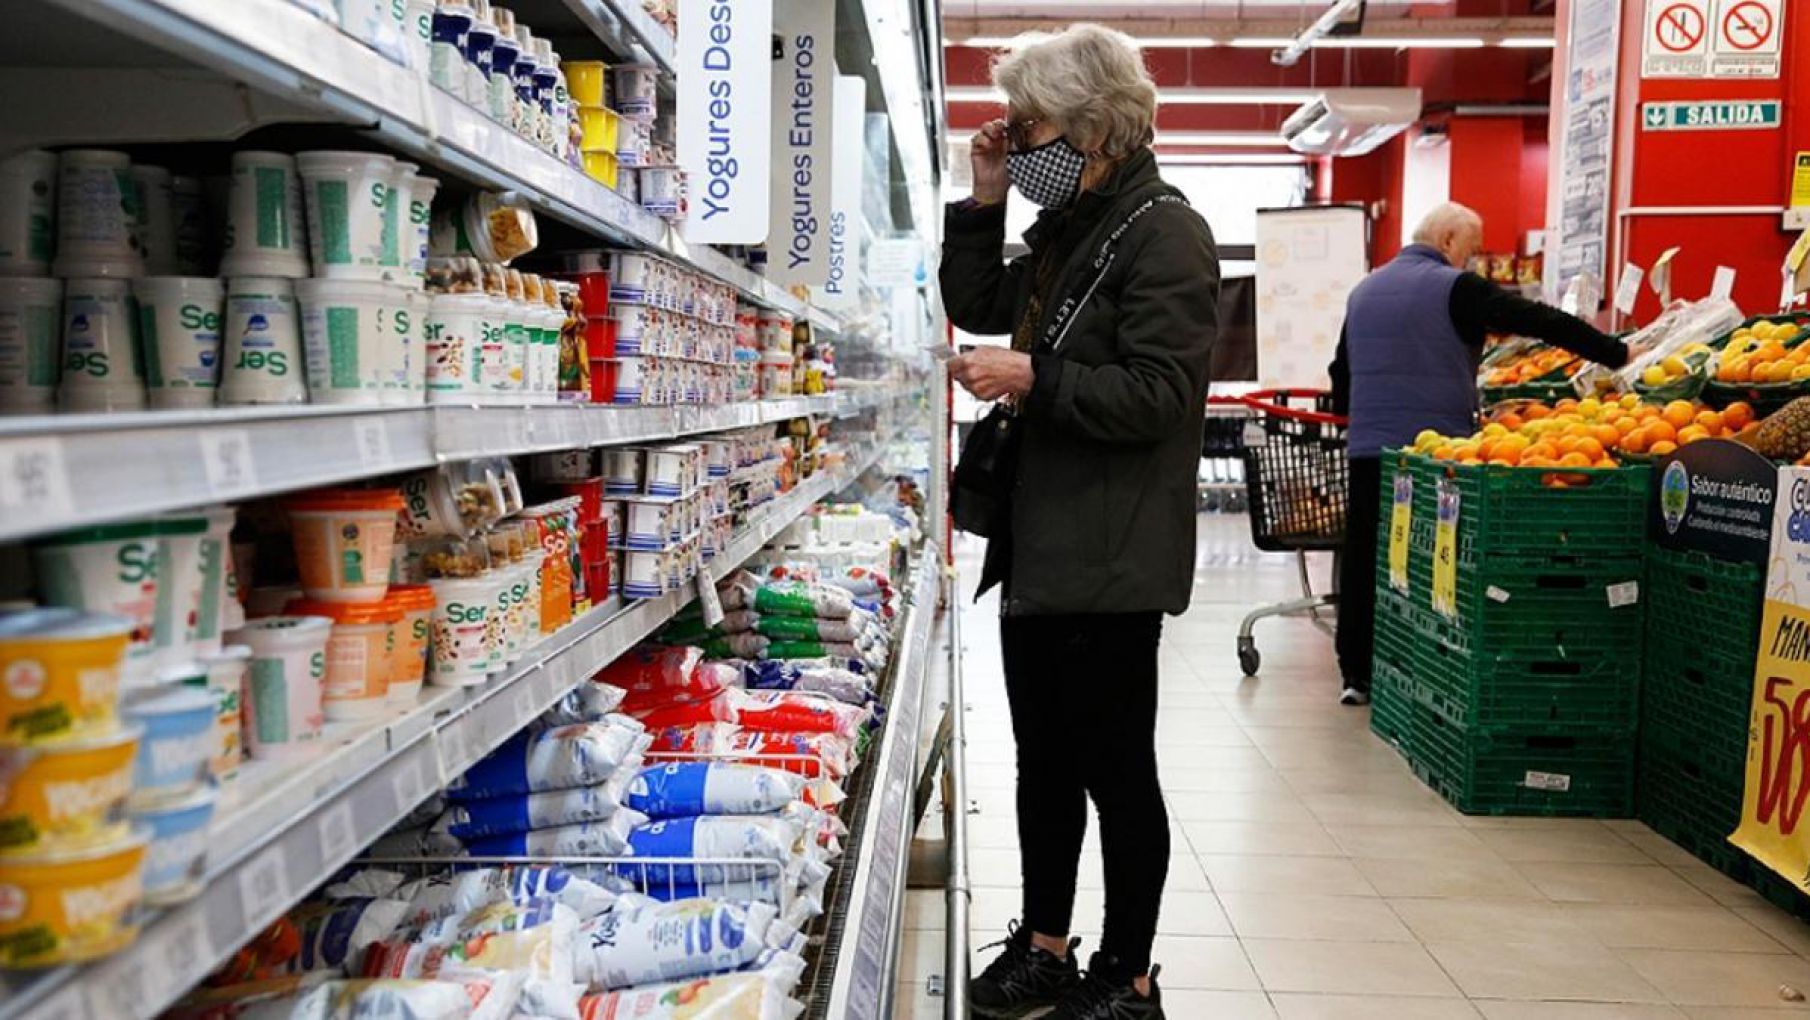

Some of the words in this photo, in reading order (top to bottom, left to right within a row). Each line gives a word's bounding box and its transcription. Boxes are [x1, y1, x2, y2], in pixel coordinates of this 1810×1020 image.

[703, 0, 731, 71] Des
[790, 34, 815, 147] Enteros
[1688, 104, 1764, 124] SALIDA
[702, 79, 738, 220] Yogures
[788, 155, 818, 269] Yogures
[825, 211, 845, 294] Postres
[1692, 473, 1720, 497] Sabor
[446, 602, 487, 623] Ser
